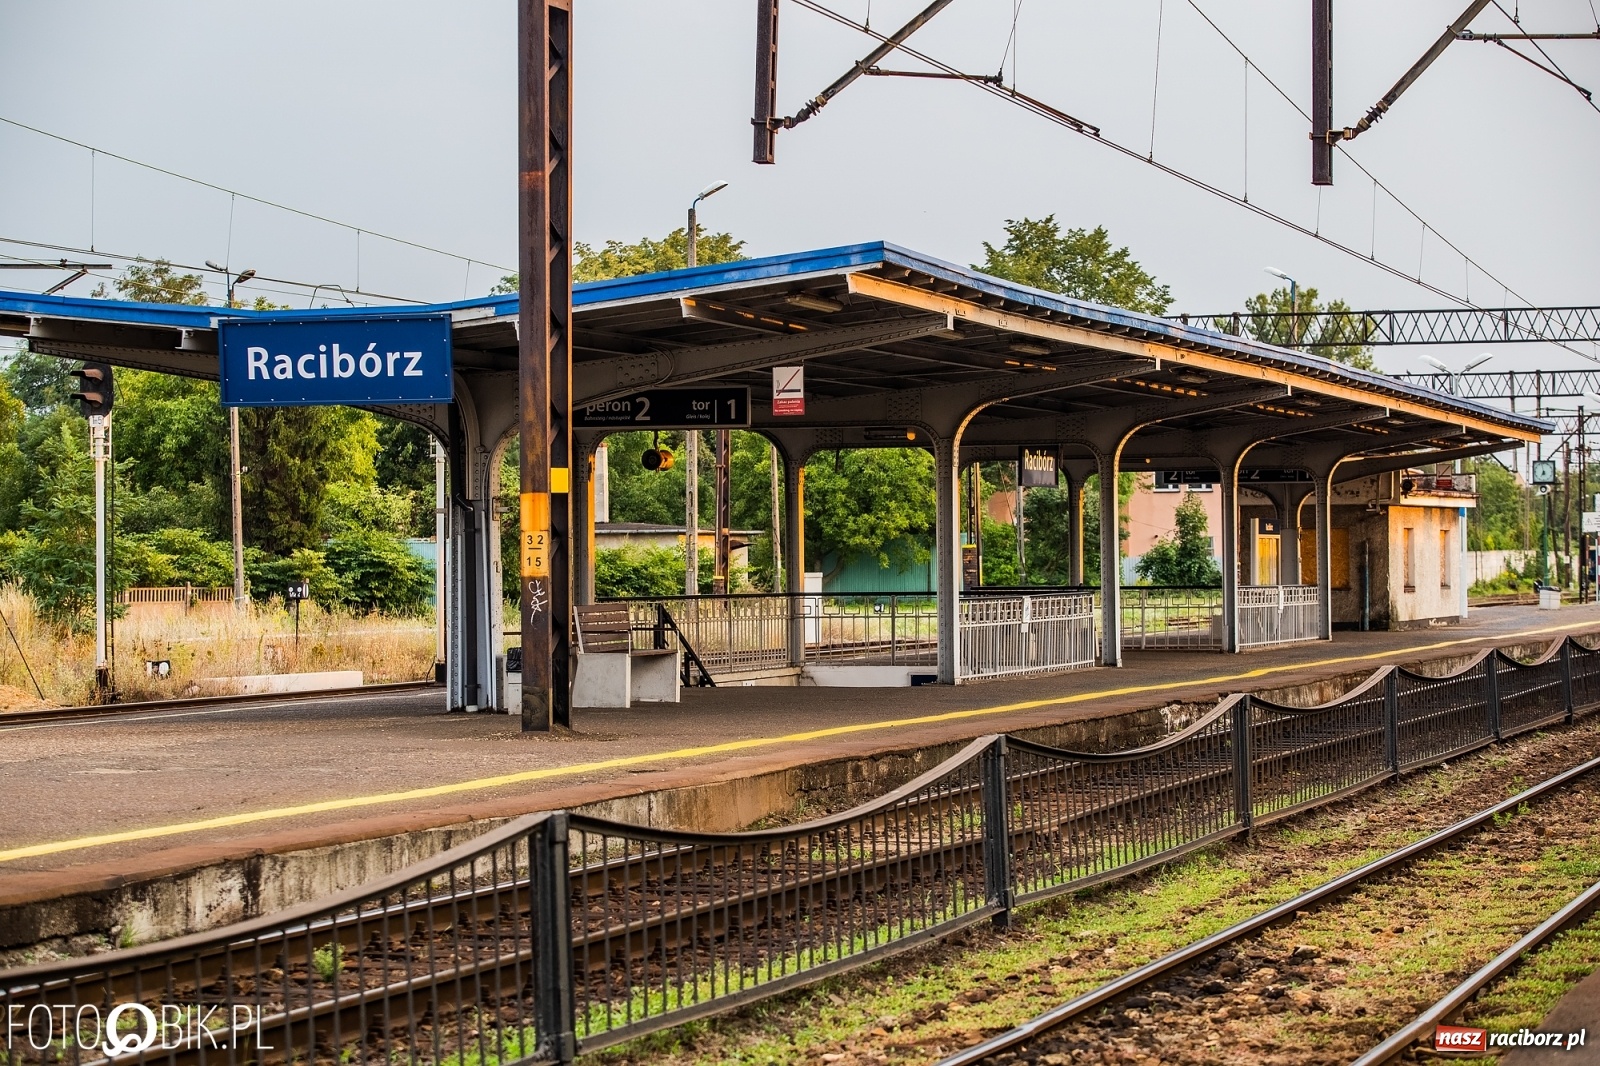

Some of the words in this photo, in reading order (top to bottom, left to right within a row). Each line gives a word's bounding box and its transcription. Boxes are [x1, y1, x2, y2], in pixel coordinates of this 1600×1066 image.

[247, 342, 424, 380] Racibórz
[634, 396, 651, 421] 2
[691, 399, 711, 411] tor
[726, 398, 736, 420] 1
[1024, 448, 1054, 472] Racibórz
